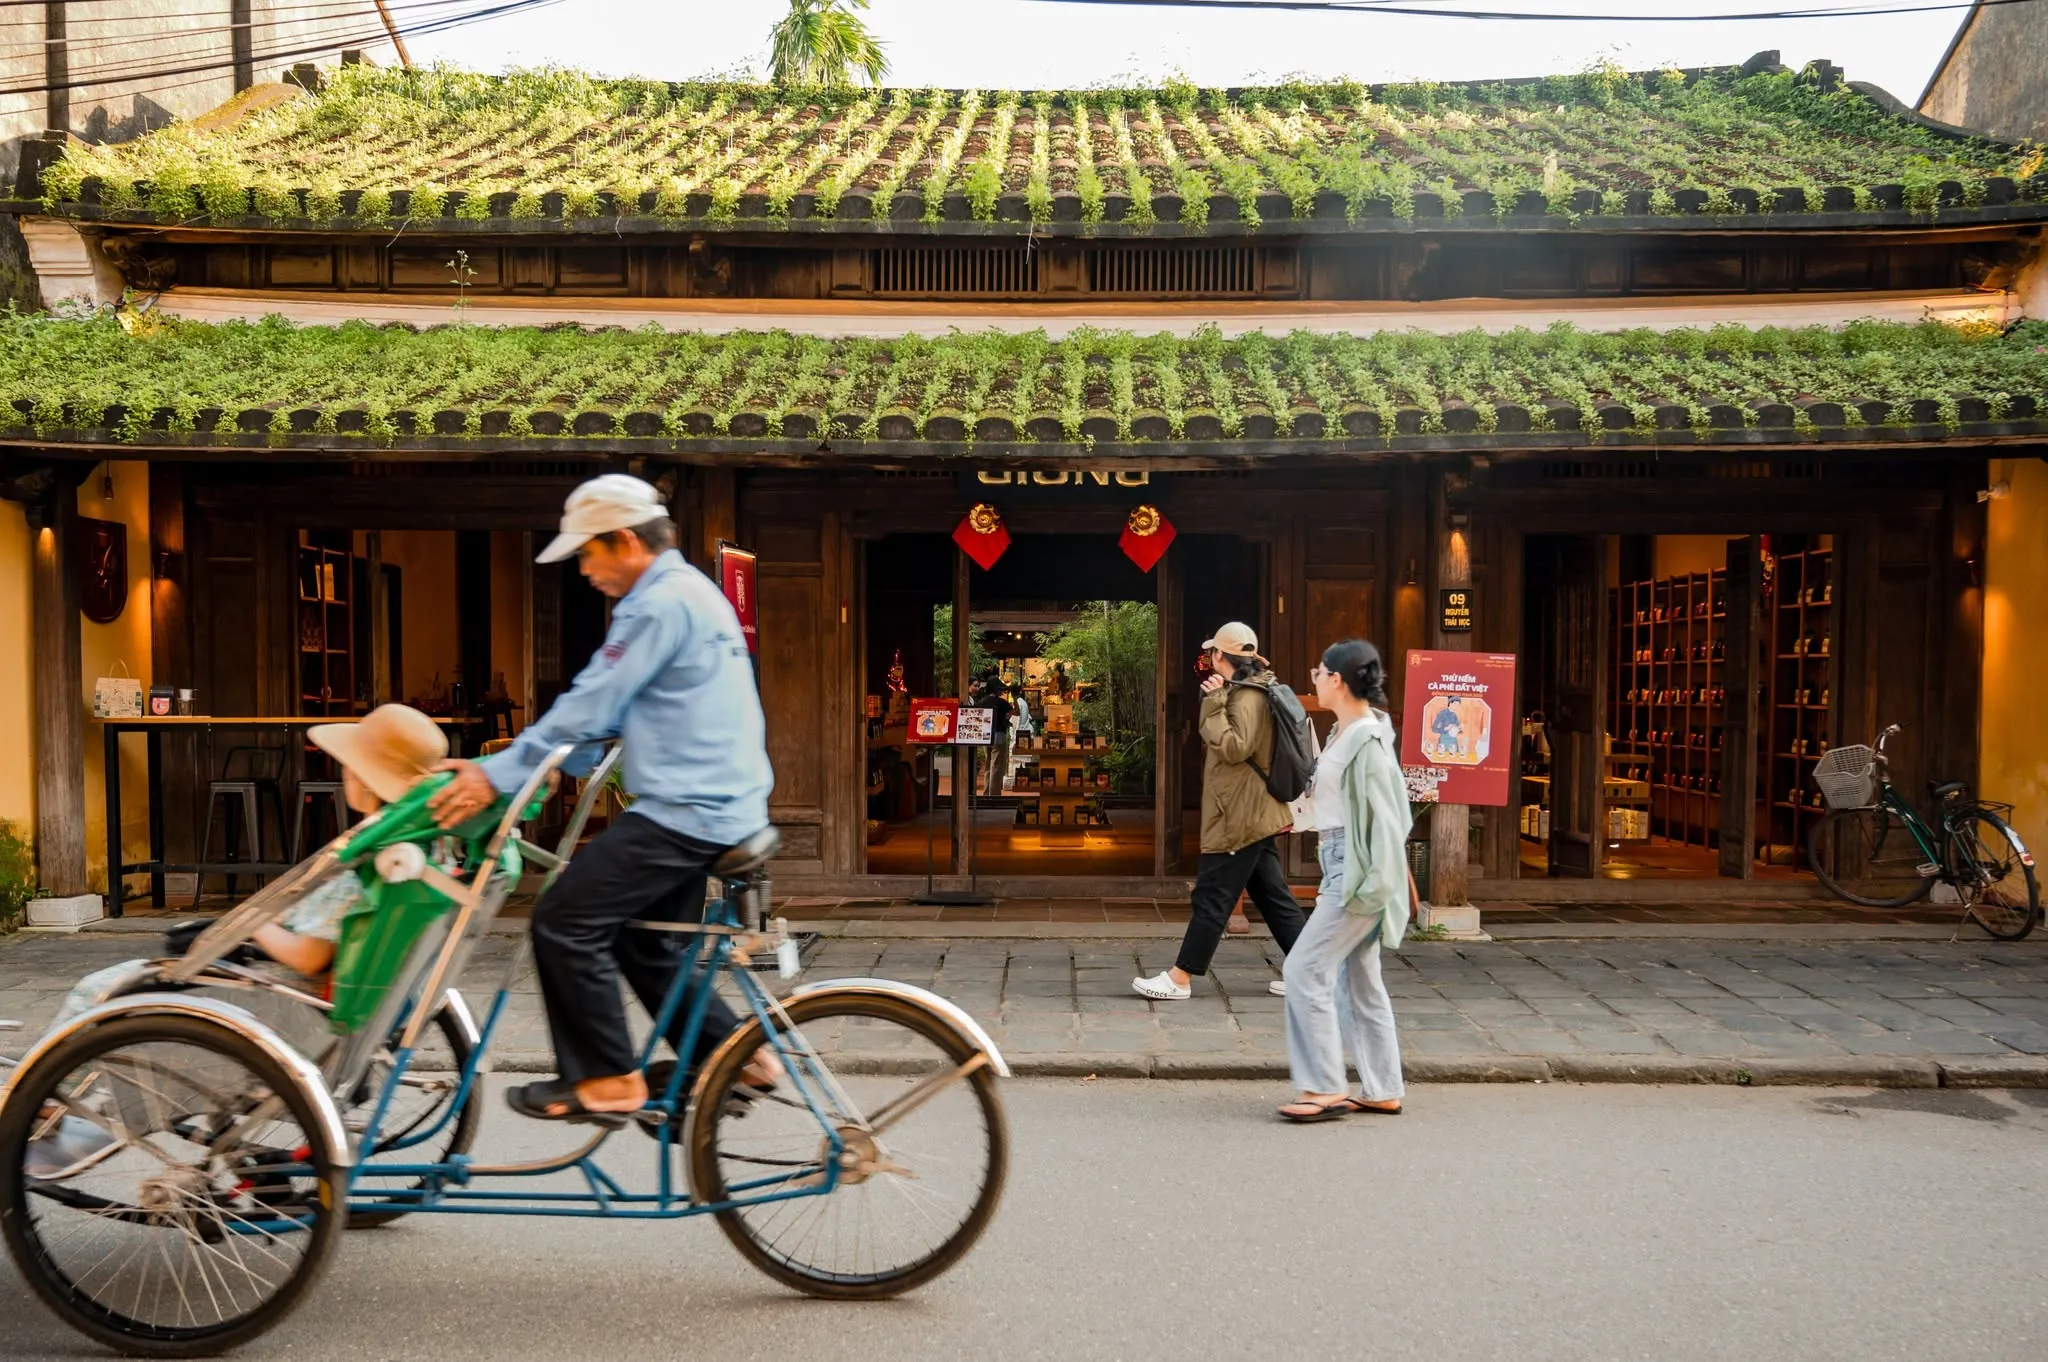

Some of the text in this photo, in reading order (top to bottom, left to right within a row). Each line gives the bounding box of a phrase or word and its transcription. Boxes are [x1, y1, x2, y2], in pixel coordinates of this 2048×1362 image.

[1449, 593, 1465, 605] 09
[1428, 682, 1438, 690] CÀ
[1439, 682, 1455, 691] PHÊ
